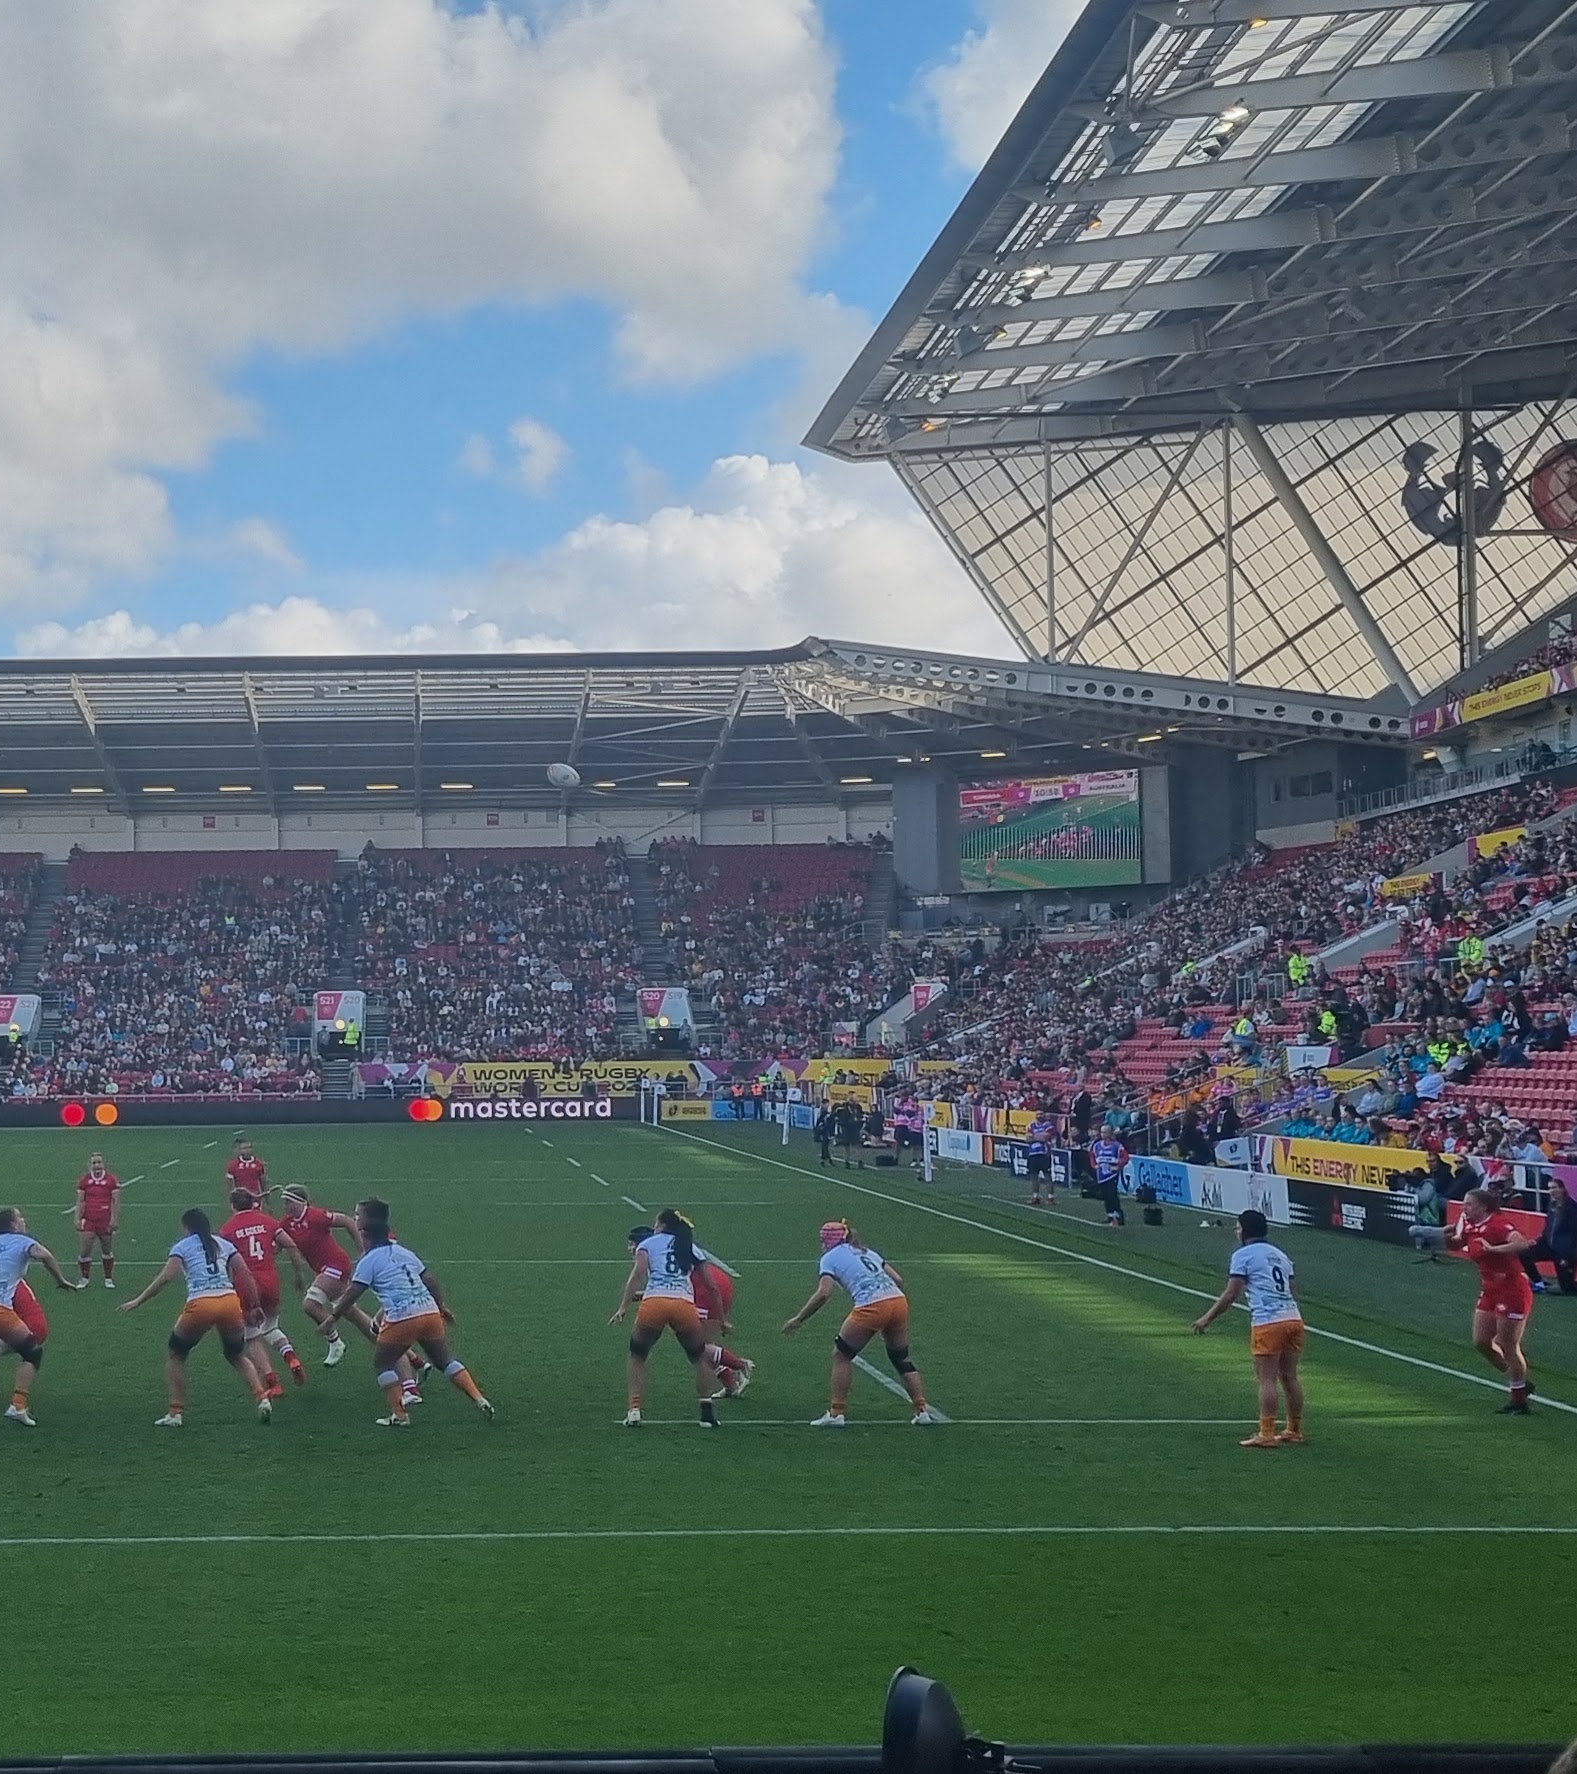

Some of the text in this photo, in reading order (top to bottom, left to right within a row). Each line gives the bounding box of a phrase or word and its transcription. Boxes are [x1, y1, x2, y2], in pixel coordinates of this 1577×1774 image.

[319, 996, 335, 1005] S21
[642, 992, 660, 1000] S20
[580, 1067, 651, 1080] RUGBY
[474, 1081, 547, 1093] WORD
[450, 1098, 612, 1119] mastercard
[1290, 1156, 1312, 1175] THIS
[1312, 1159, 1360, 1182] ENERGY
[249, 1236, 264, 1261] 4
[665, 1252, 680, 1274] 8
[859, 1255, 879, 1273] 6
[401, 1264, 415, 1286] 1
[1270, 1265, 1285, 1293] 9
